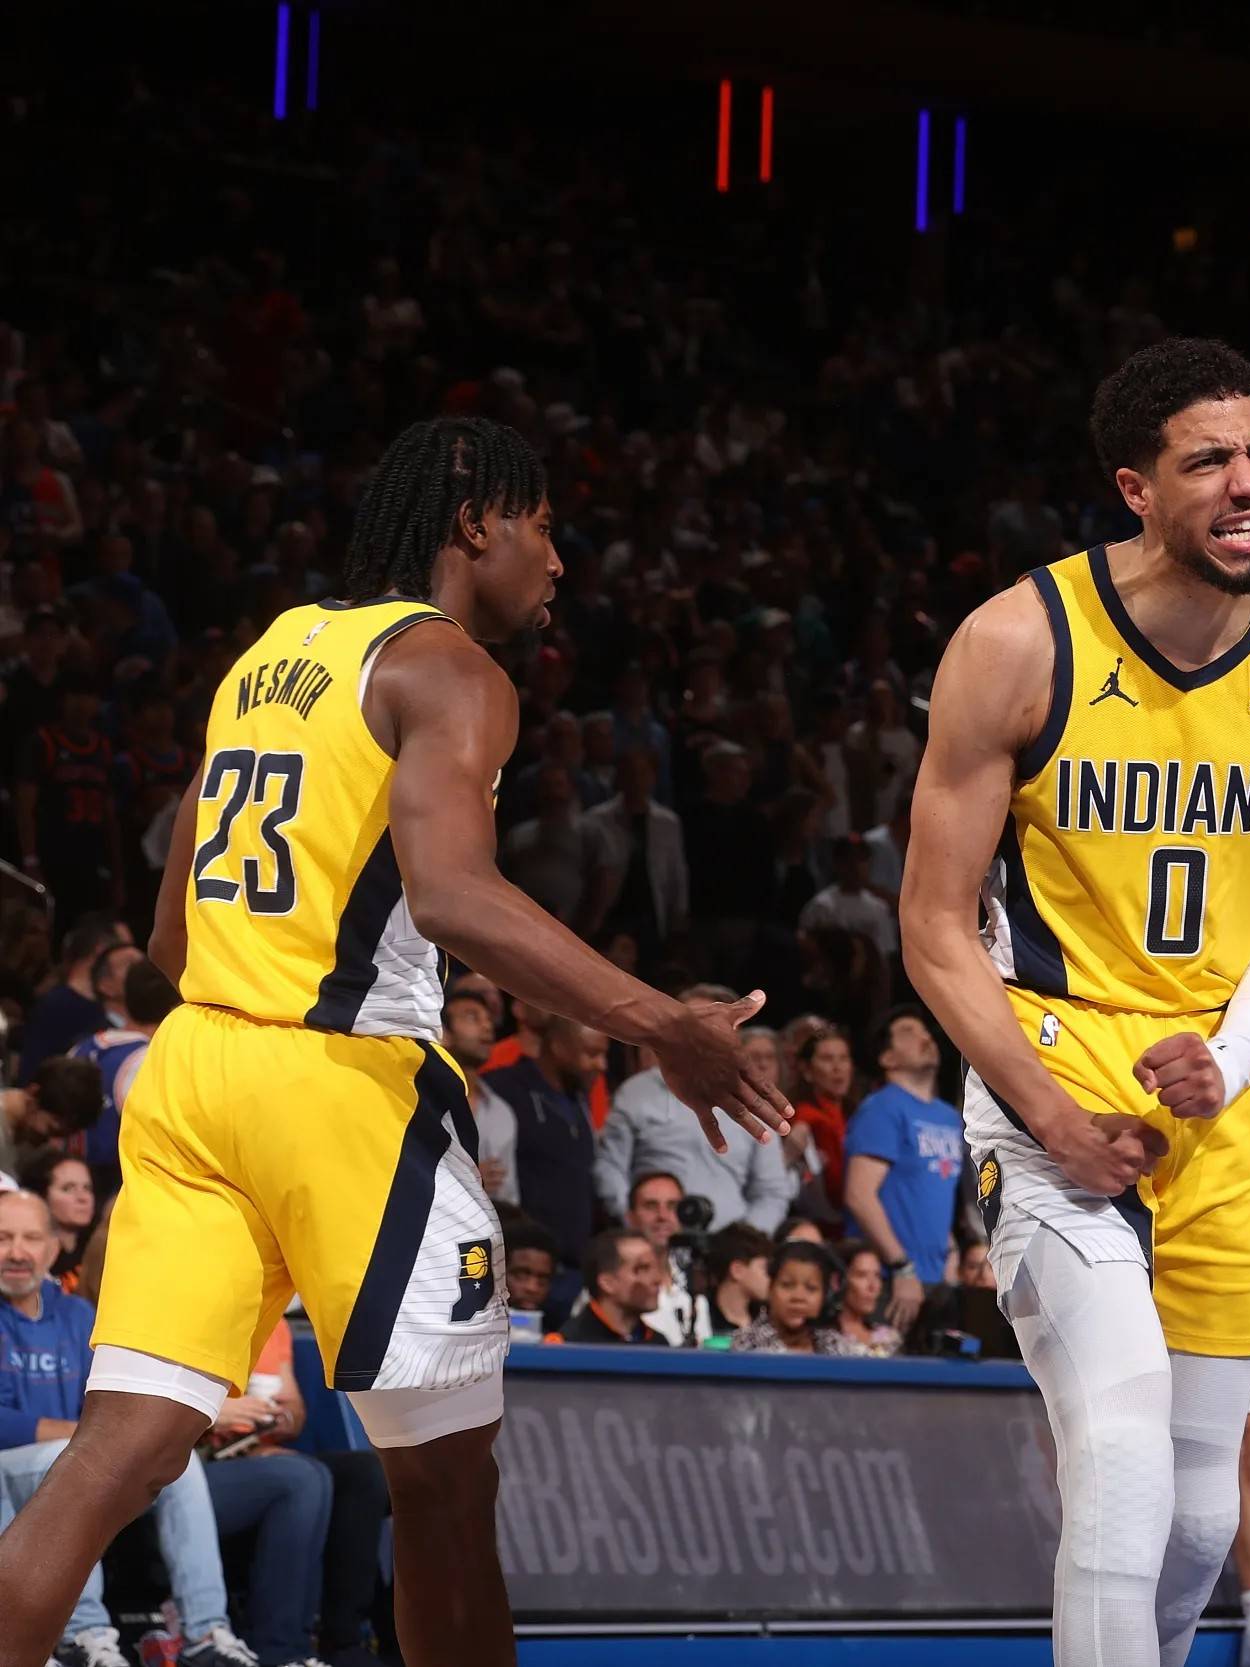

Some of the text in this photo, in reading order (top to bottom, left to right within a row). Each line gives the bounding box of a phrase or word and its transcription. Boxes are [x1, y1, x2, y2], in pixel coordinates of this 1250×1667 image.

[236, 657, 334, 721] NESMITH
[193, 748, 305, 916] 23
[1144, 846, 1209, 957] 0
